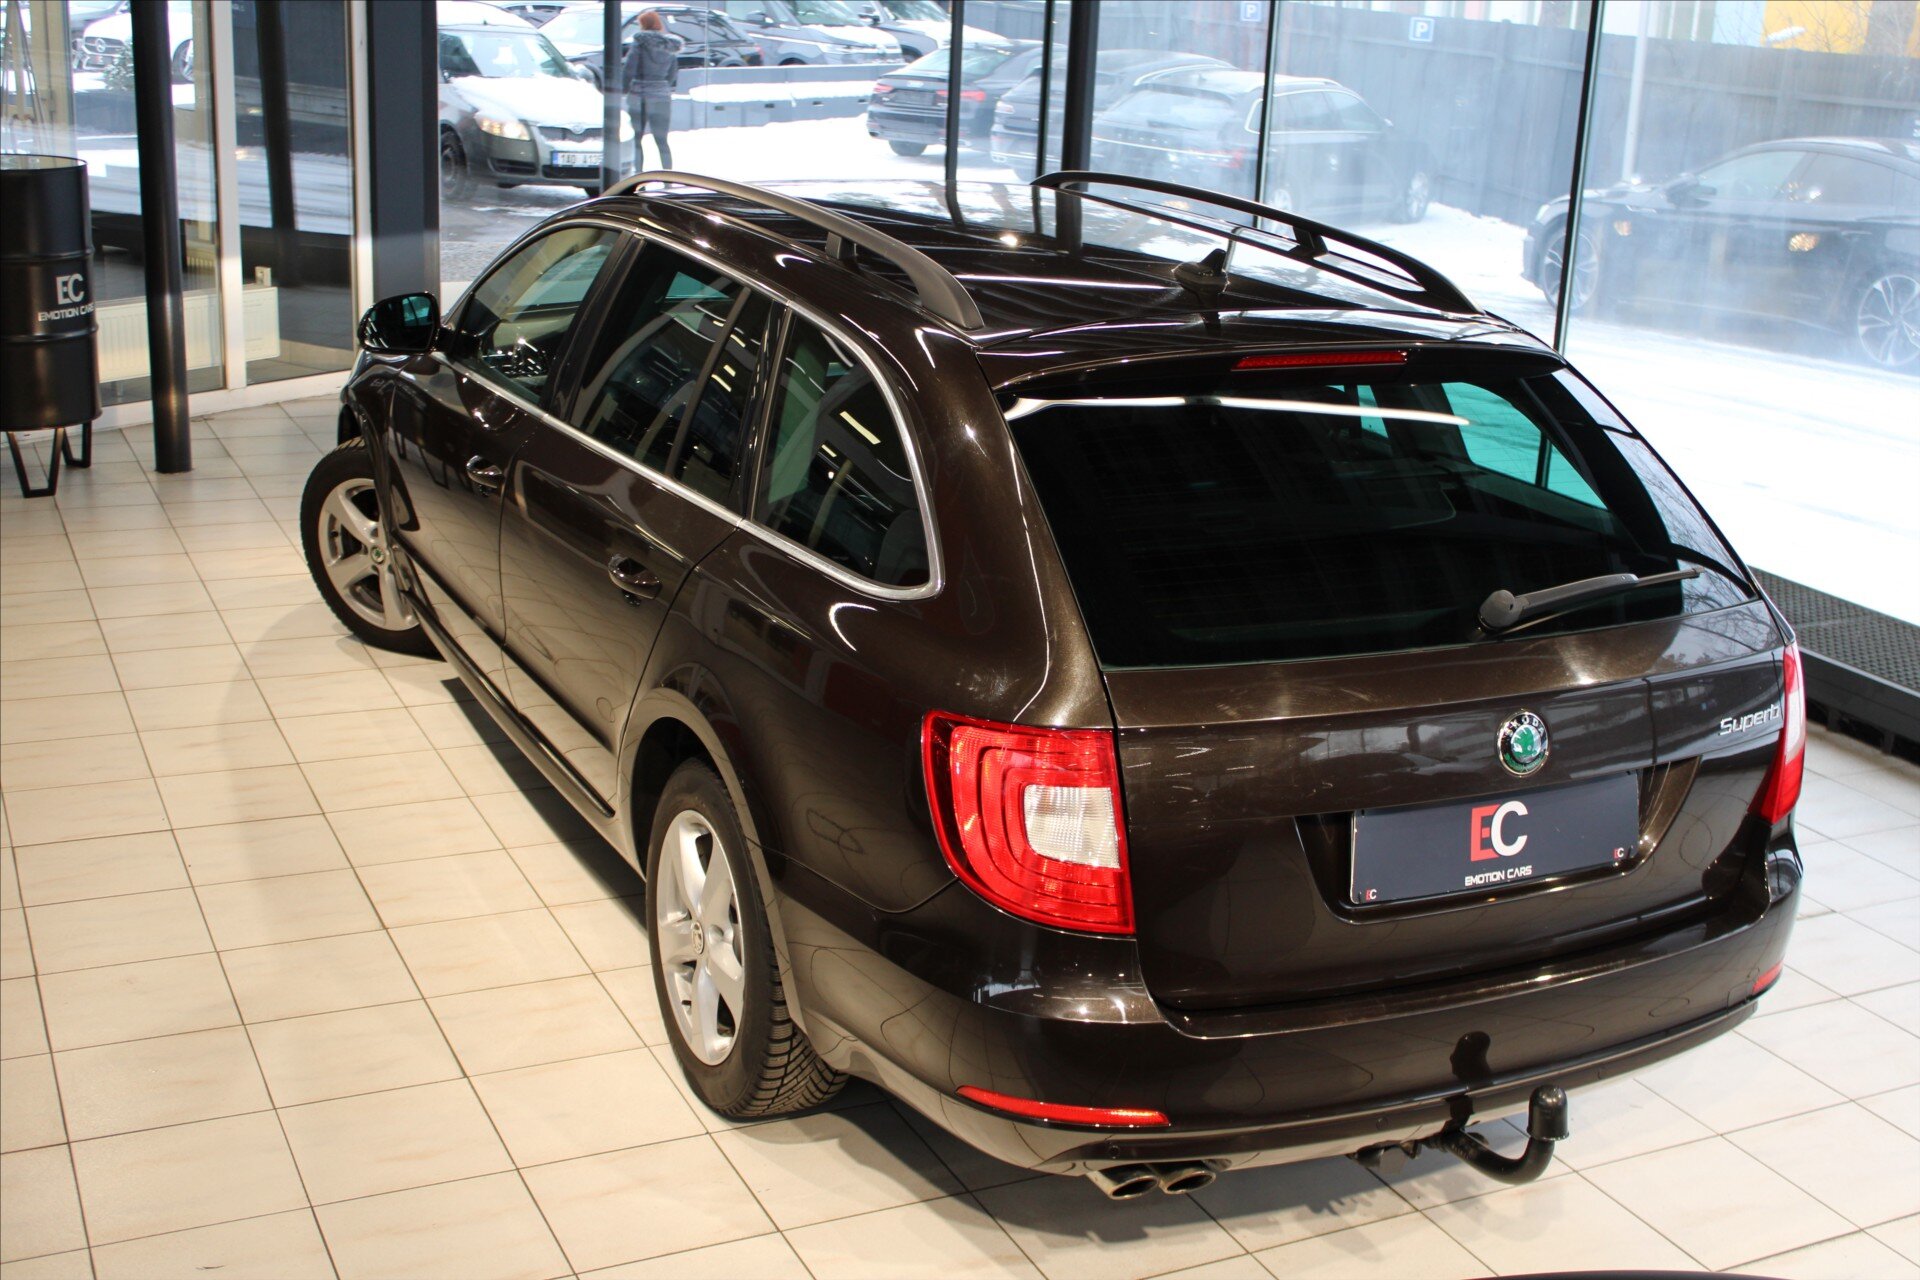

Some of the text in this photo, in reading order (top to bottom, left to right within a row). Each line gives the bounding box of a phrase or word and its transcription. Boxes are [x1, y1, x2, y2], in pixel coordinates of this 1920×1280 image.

[1415, 21, 1428, 38] P
[56, 273, 85, 305] EC
[38, 307, 79, 322] EMOTION
[1720, 704, 1780, 736] Superb
[1470, 800, 1528, 862] EC
[1464, 865, 1533, 887] EMOTION CARS
